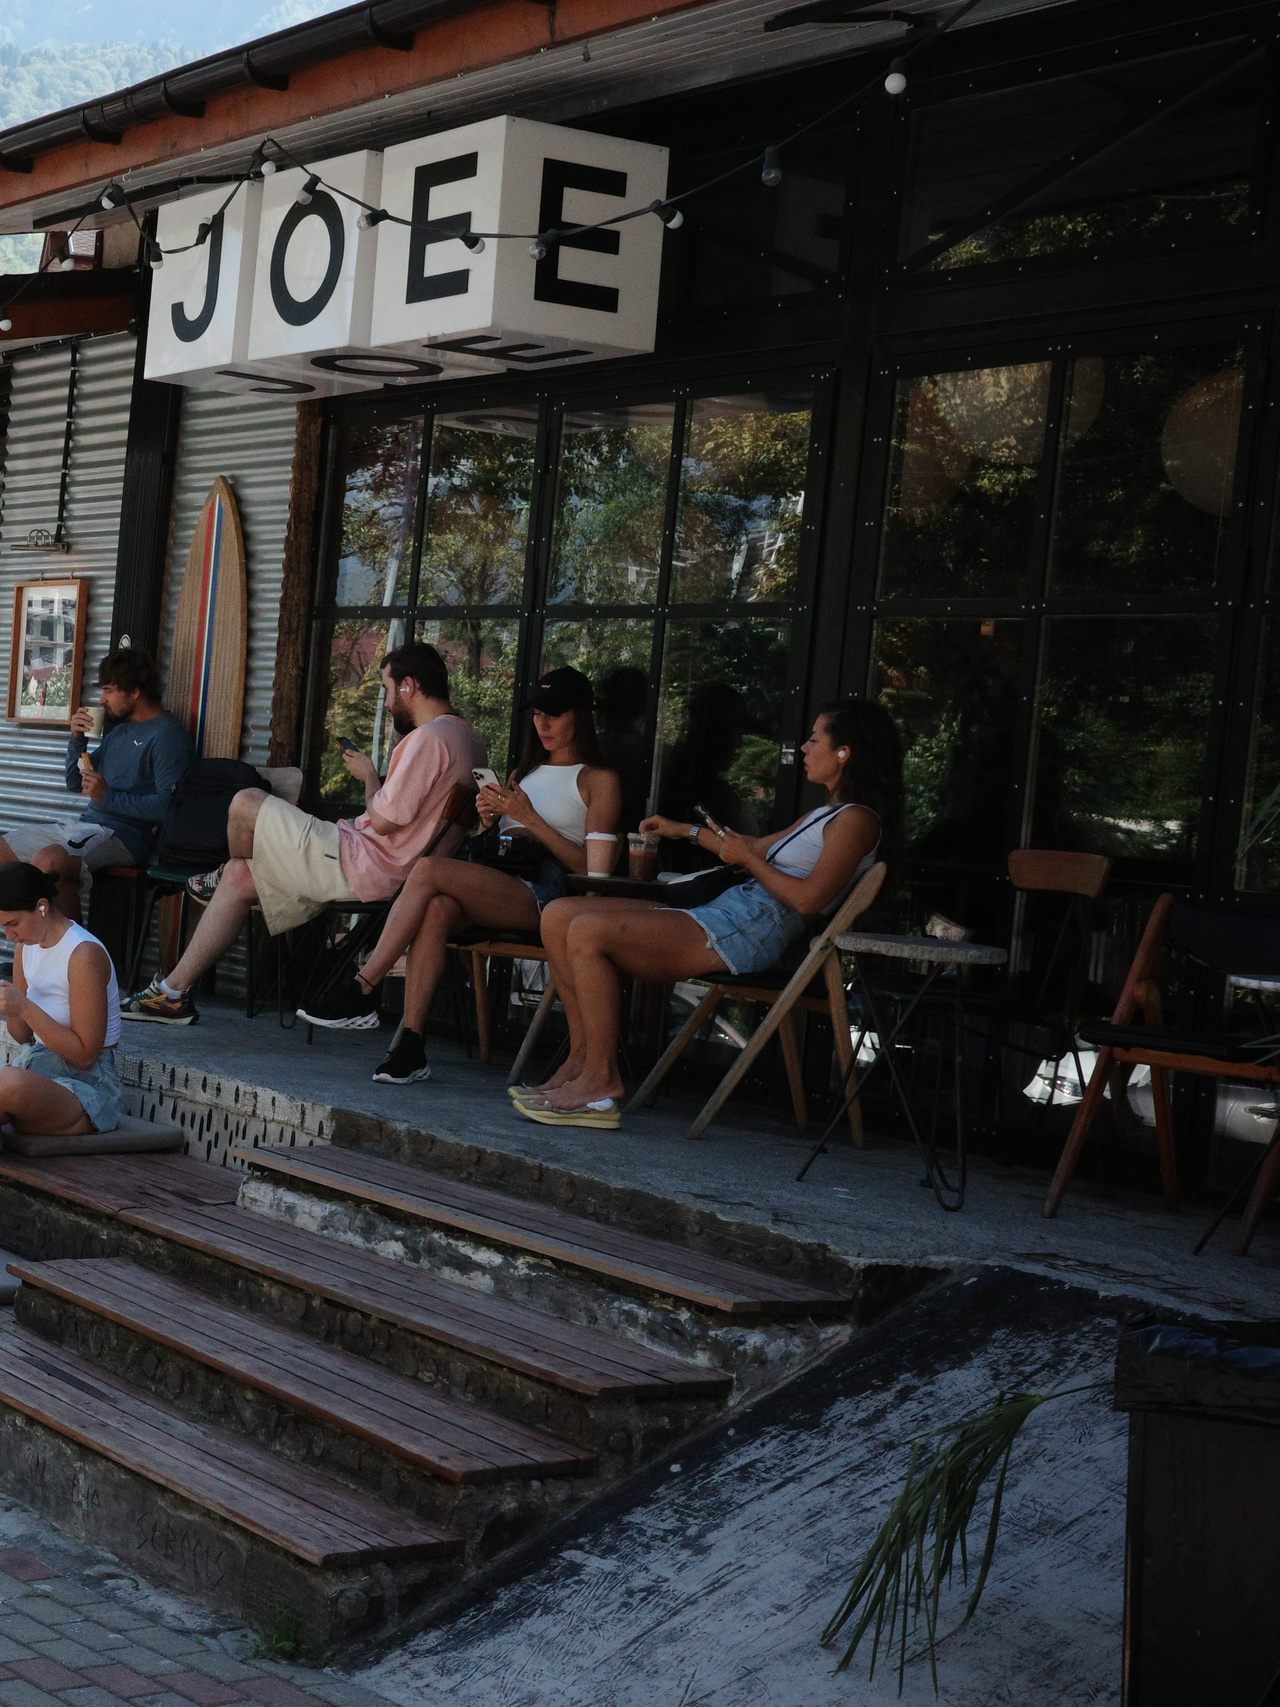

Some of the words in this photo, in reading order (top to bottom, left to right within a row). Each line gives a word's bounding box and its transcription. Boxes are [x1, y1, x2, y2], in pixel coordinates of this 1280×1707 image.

[170, 151, 479, 343] JOE
[533, 157, 628, 314] E
[214, 334, 594, 394] JOE
